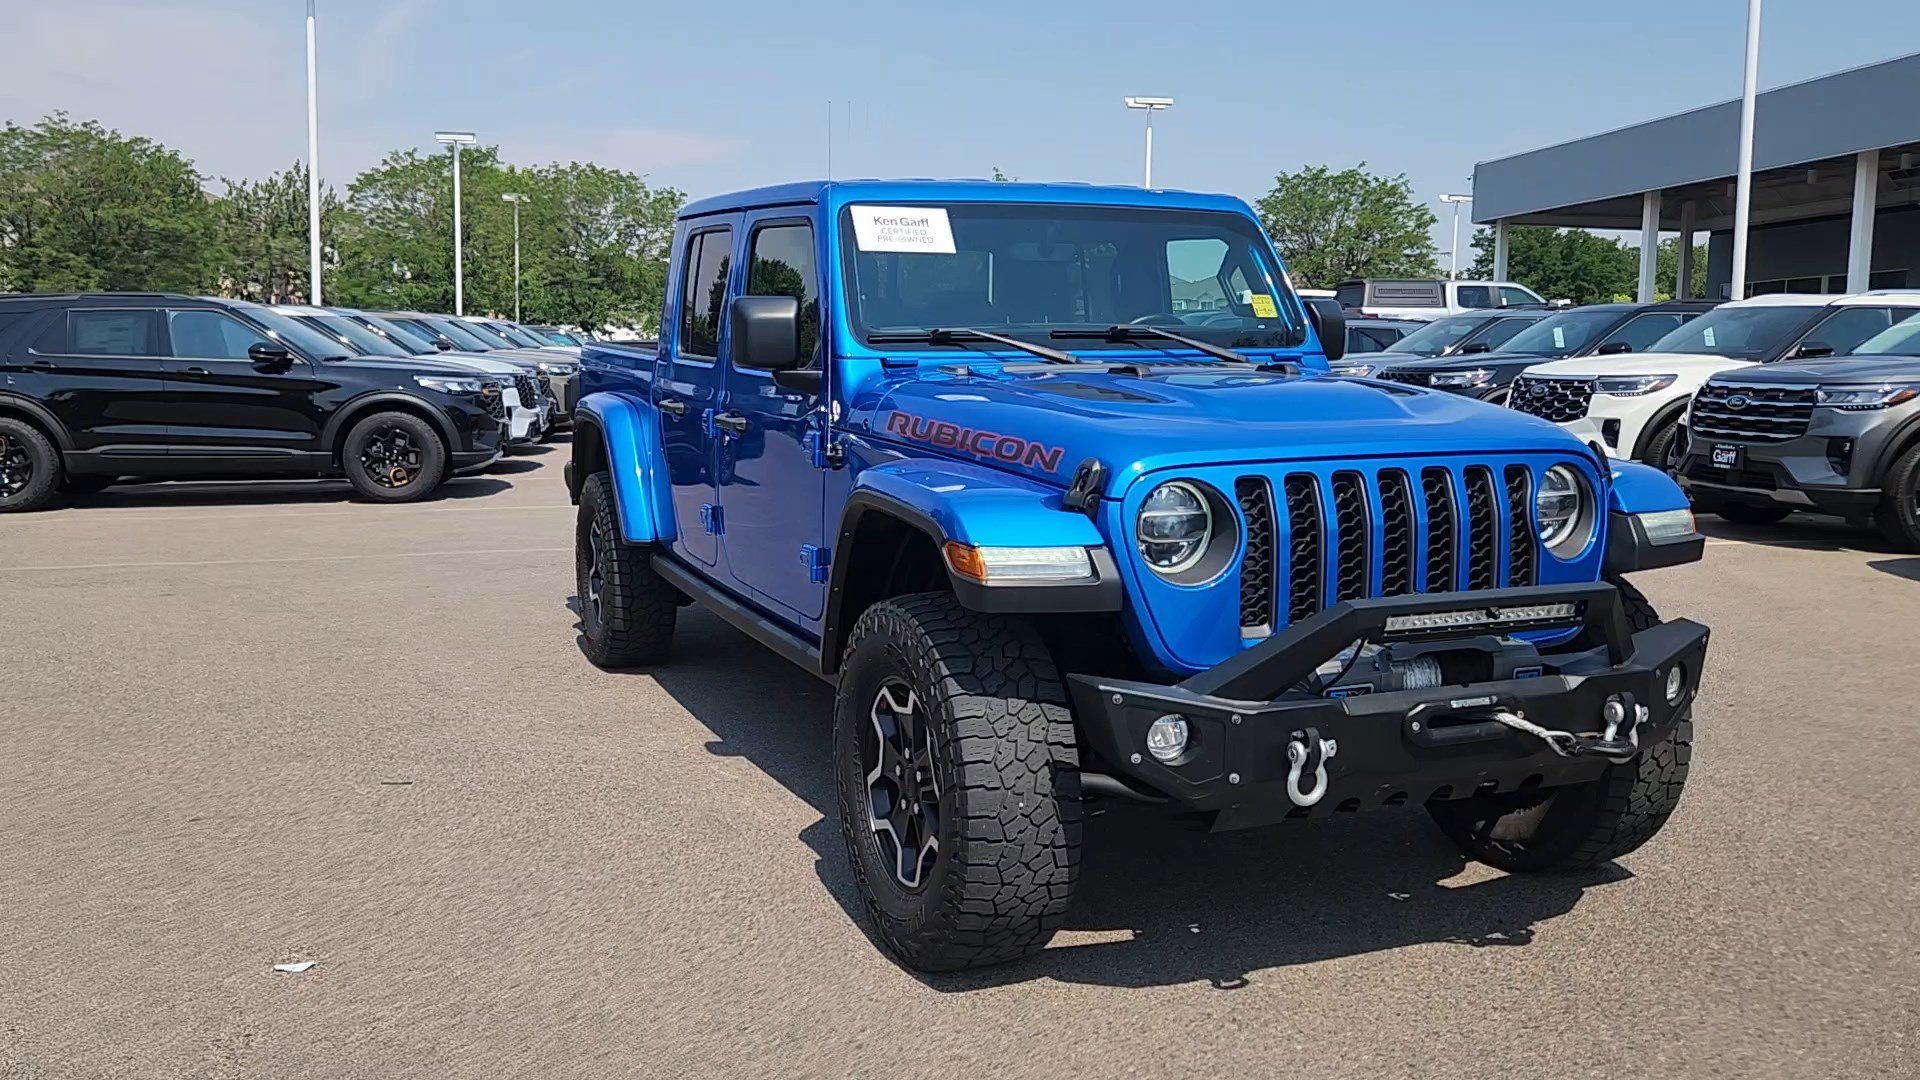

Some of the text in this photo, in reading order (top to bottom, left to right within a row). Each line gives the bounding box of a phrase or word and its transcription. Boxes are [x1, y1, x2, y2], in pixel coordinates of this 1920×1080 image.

[873, 216, 929, 227] Ken Garff
[881, 227, 927, 236] CERTIFIED
[877, 235, 934, 244] PRE-OWNED
[884, 411, 1065, 473] RUBICON
[1712, 449, 1737, 464] Garff
